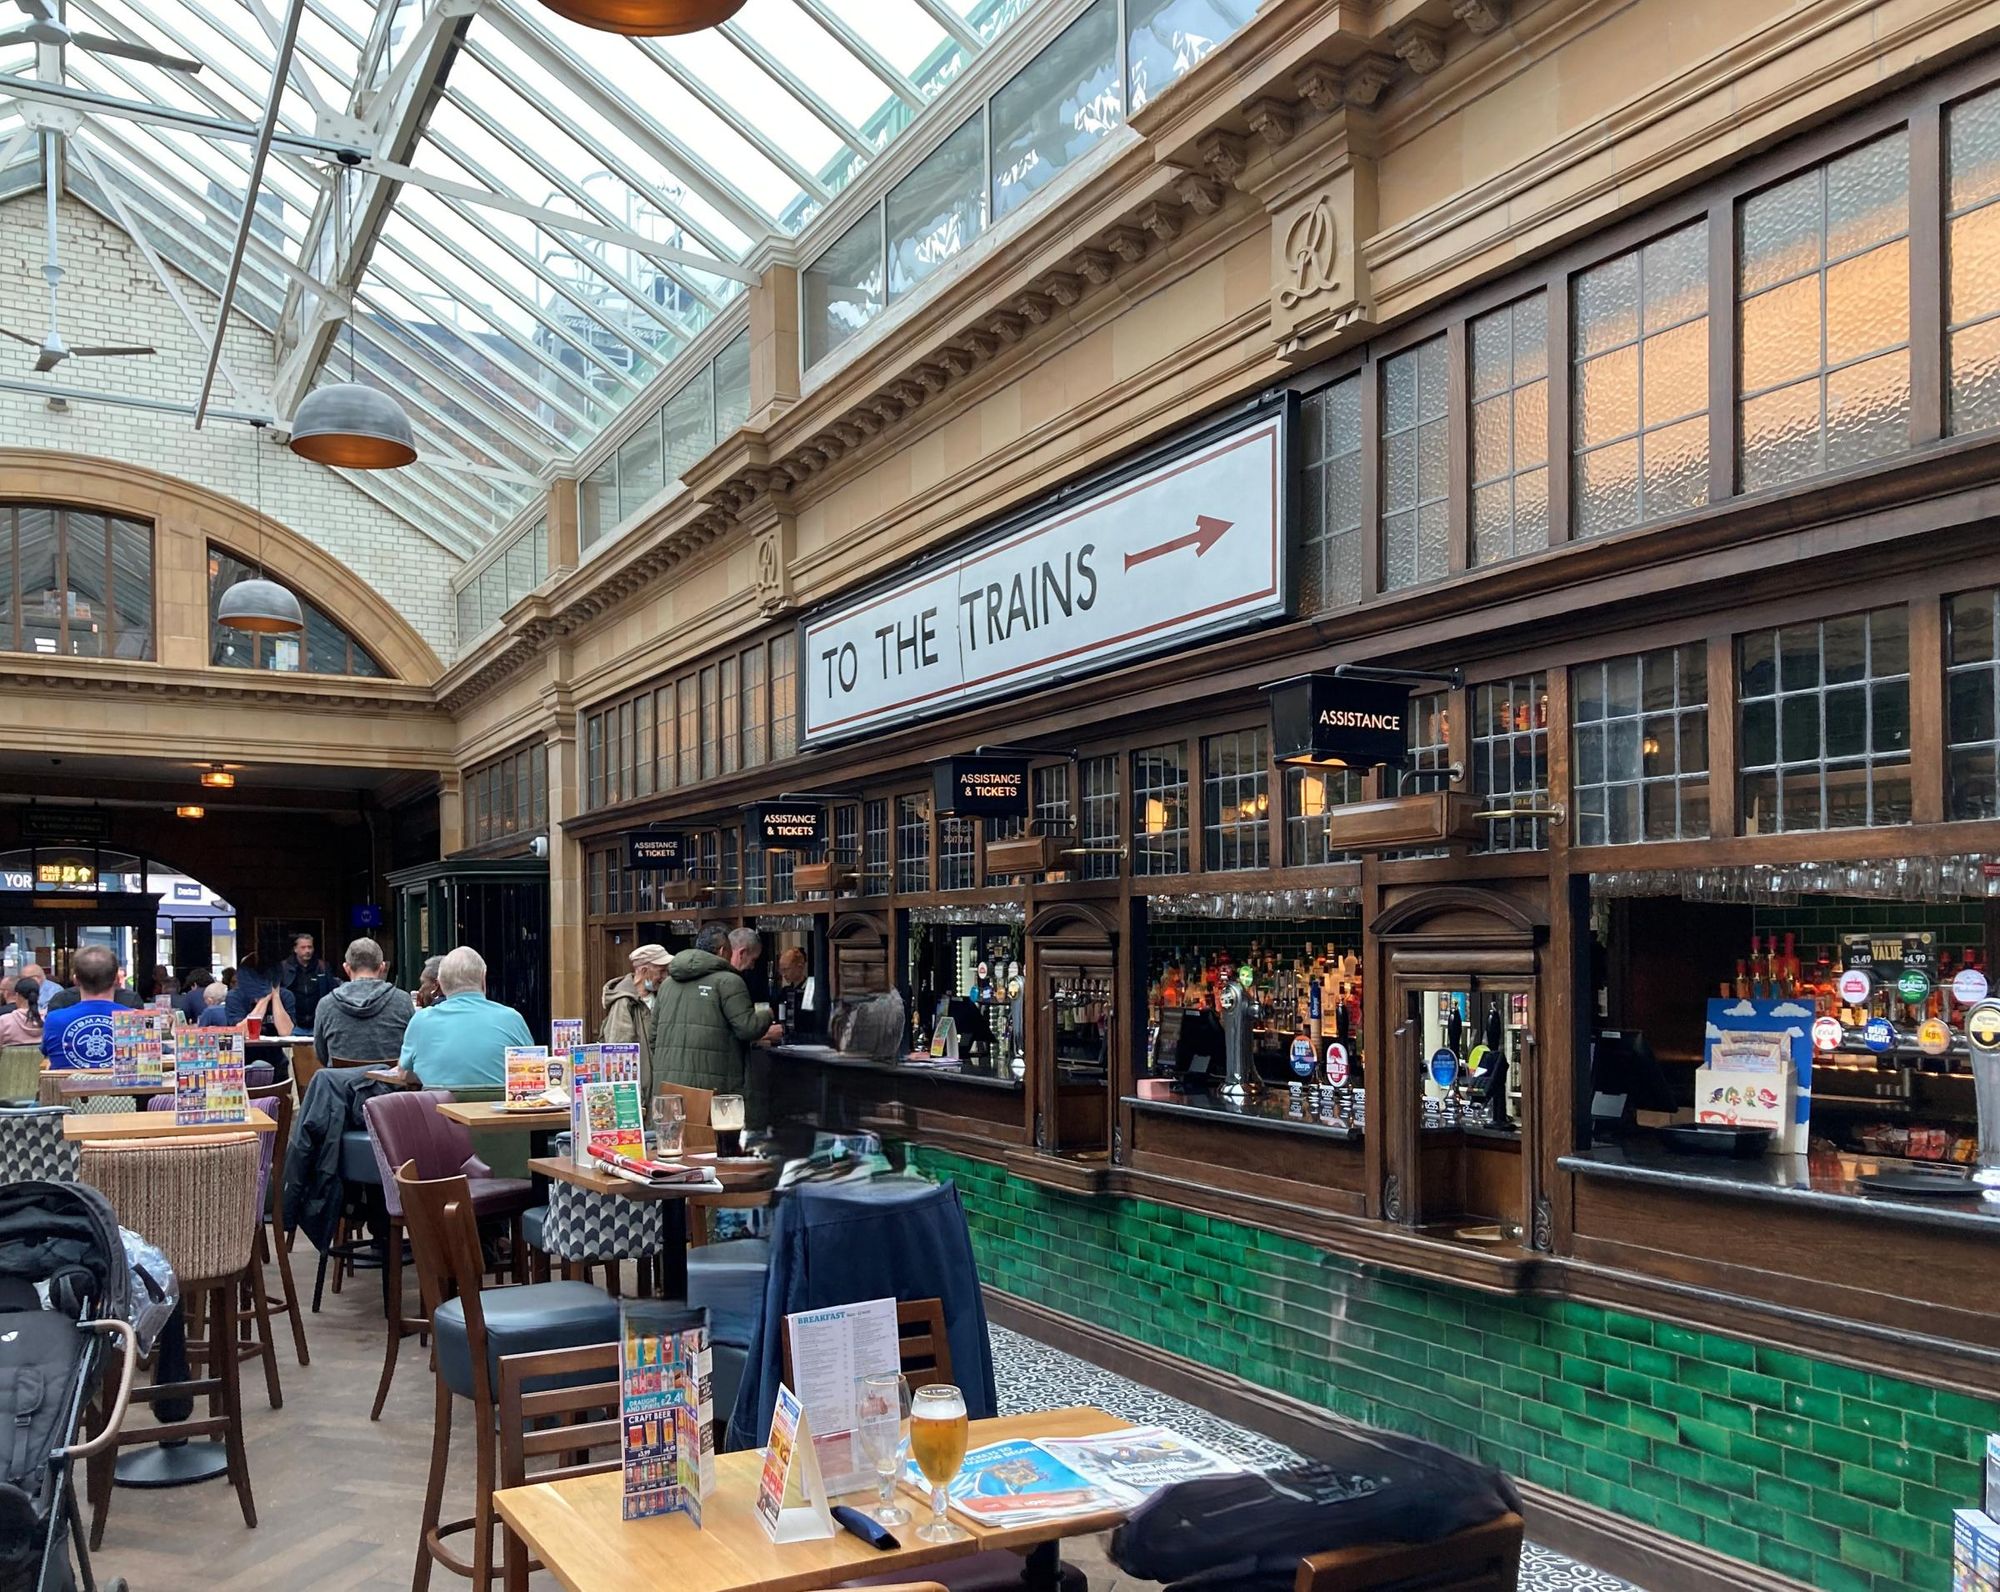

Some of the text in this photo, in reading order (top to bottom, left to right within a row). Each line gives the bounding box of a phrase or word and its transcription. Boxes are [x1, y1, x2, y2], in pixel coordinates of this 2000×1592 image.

[822, 543, 1097, 699] TO THE TRAINS
[1319, 709, 1400, 731] ASSISTANCE
[960, 773, 1021, 786] ASSISTANCE
[964, 786, 1018, 797] & TICKETS
[763, 813, 817, 826] ASSISTANCE
[766, 825, 814, 836] & TICKETS
[634, 840, 678, 851] ASSISTANCE
[637, 848, 676, 858] & TICKETS
[41, 865, 60, 874] FIRE
[41, 874, 61, 882] EXIT
[1871, 945, 1904, 961] VALUE
[1903, 953, 1926, 964] £4.99
[1850, 954, 1872, 964] £3.49
[1867, 1025, 1888, 1036] BUD
[1864, 1033, 1891, 1043] LIGHT
[797, 1311, 845, 1325] BREAKFAST
[628, 1410, 672, 1424] CRAFT BEER
